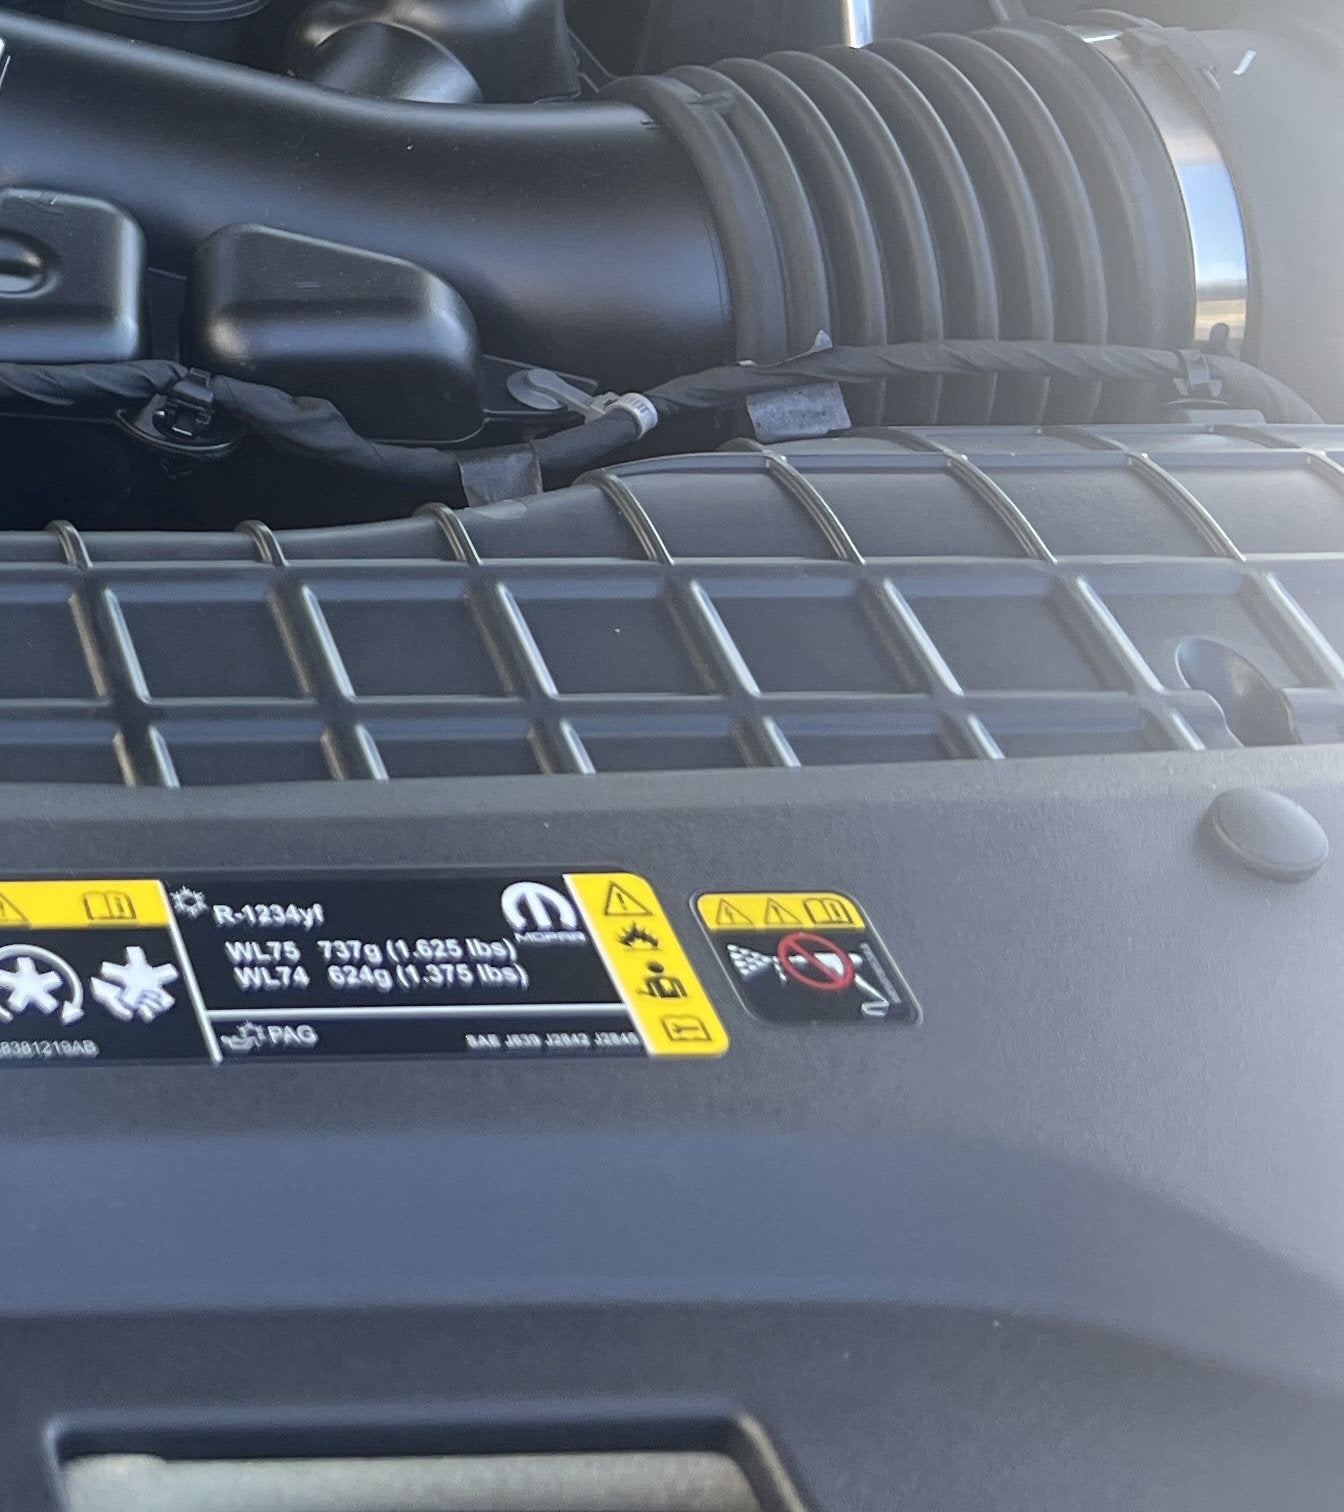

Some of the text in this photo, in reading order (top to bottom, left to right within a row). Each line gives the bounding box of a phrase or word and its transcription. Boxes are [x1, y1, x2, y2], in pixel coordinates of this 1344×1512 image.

[213, 904, 324, 931] R-1234yf
[225, 937, 518, 965] WL75 737g (1.625 lbs)
[234, 962, 529, 992] WL74 624g (1.375 lbs)
[267, 1024, 319, 1046] PAG
